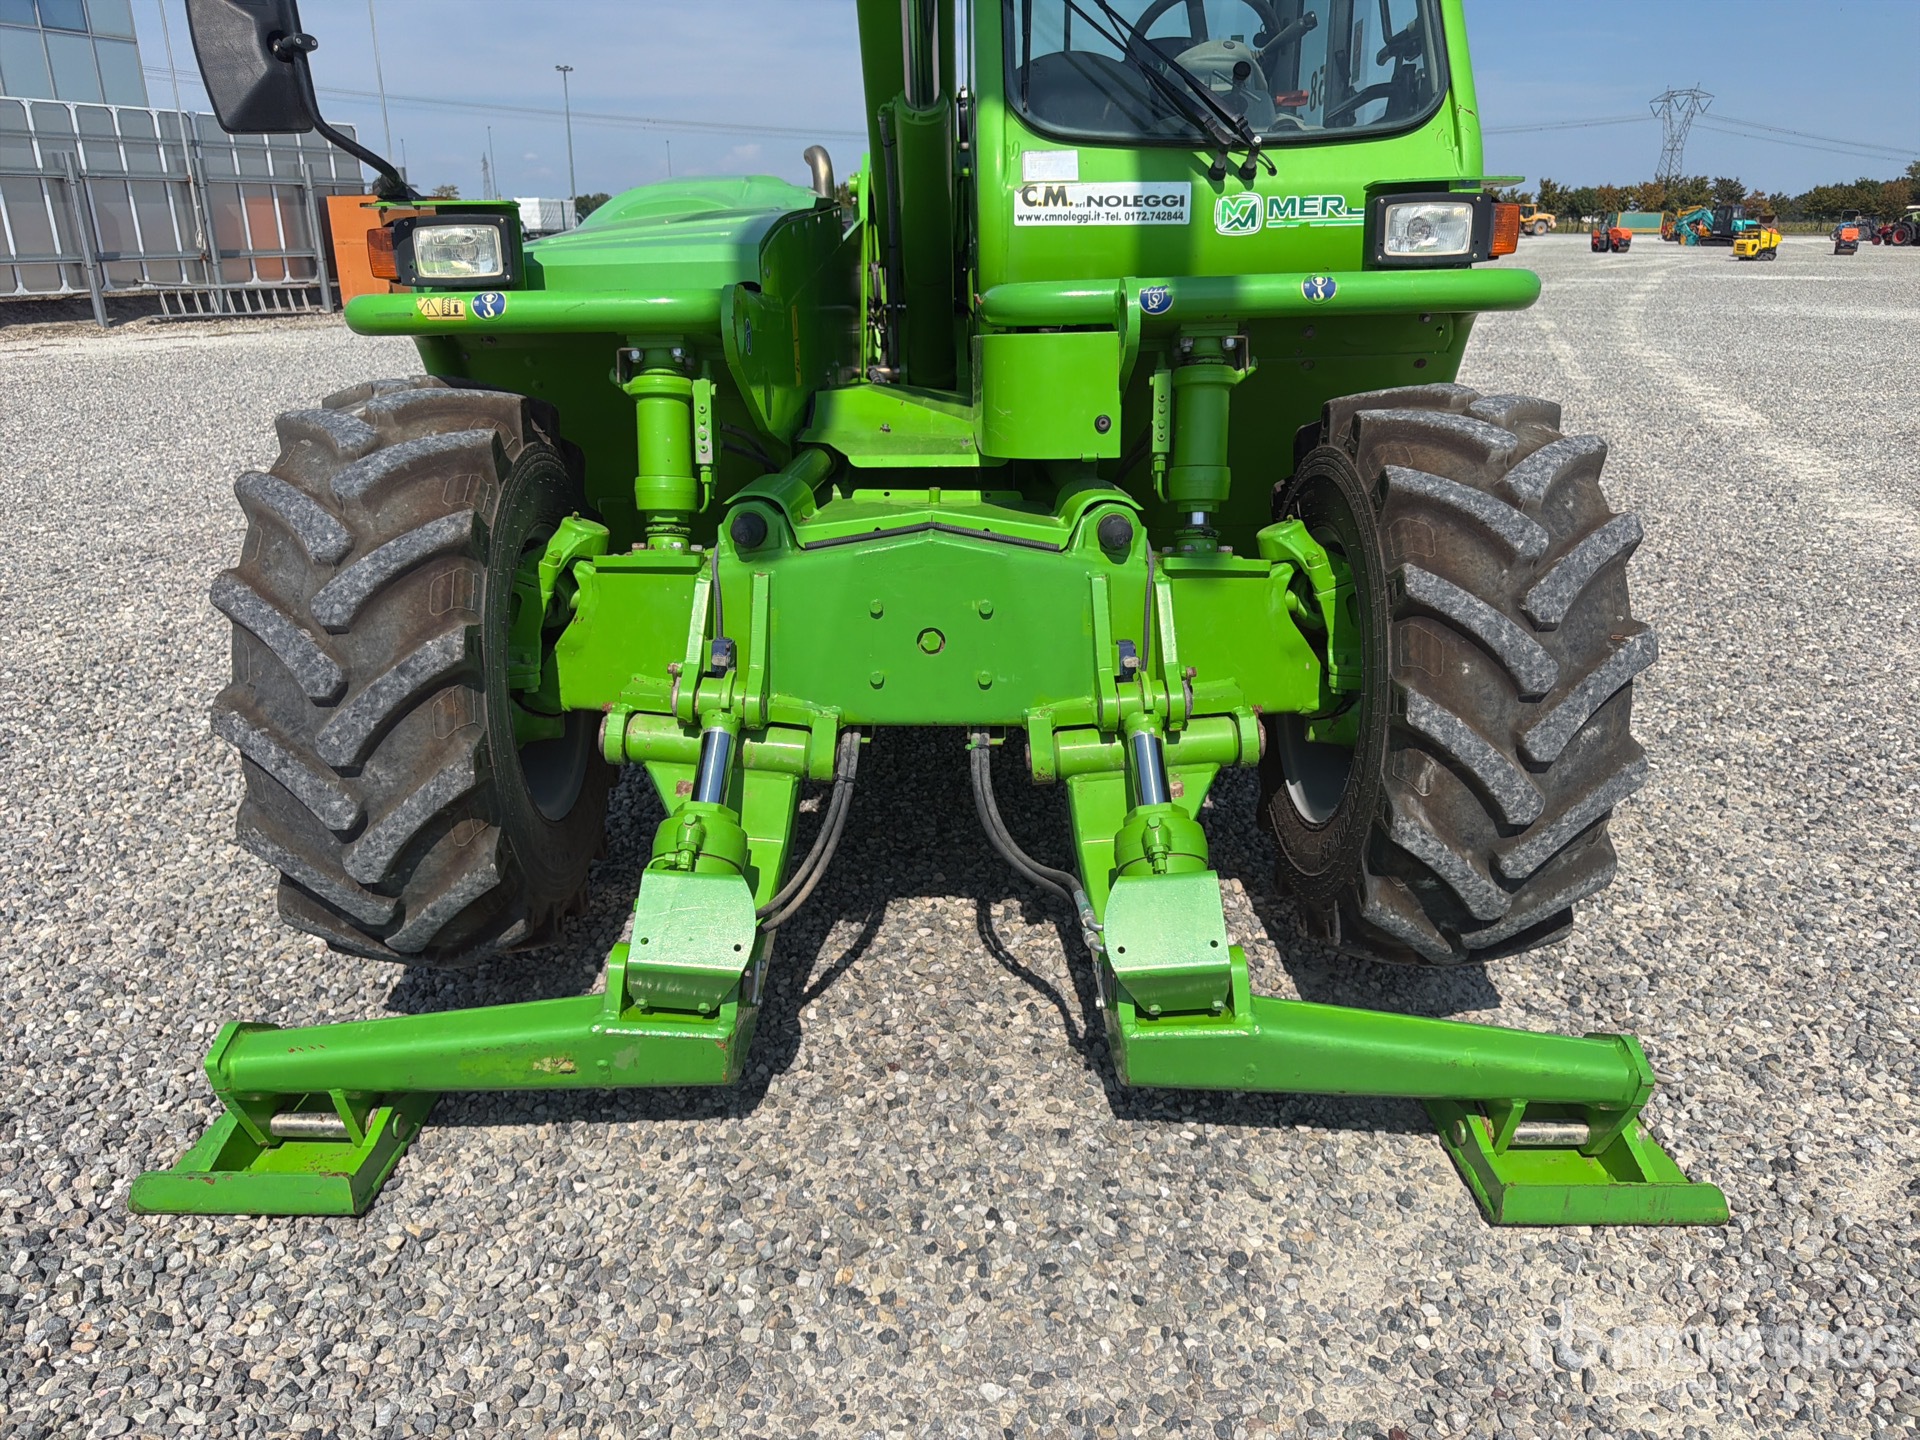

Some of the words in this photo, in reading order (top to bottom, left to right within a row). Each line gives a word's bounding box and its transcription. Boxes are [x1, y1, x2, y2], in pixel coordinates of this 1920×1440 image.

[1022, 185, 1073, 207] C.M.
[1086, 194, 1185, 208] NOLEGGI
[1267, 195, 1364, 218] MERL
[1124, 211, 1184, 221] 0172.742844
